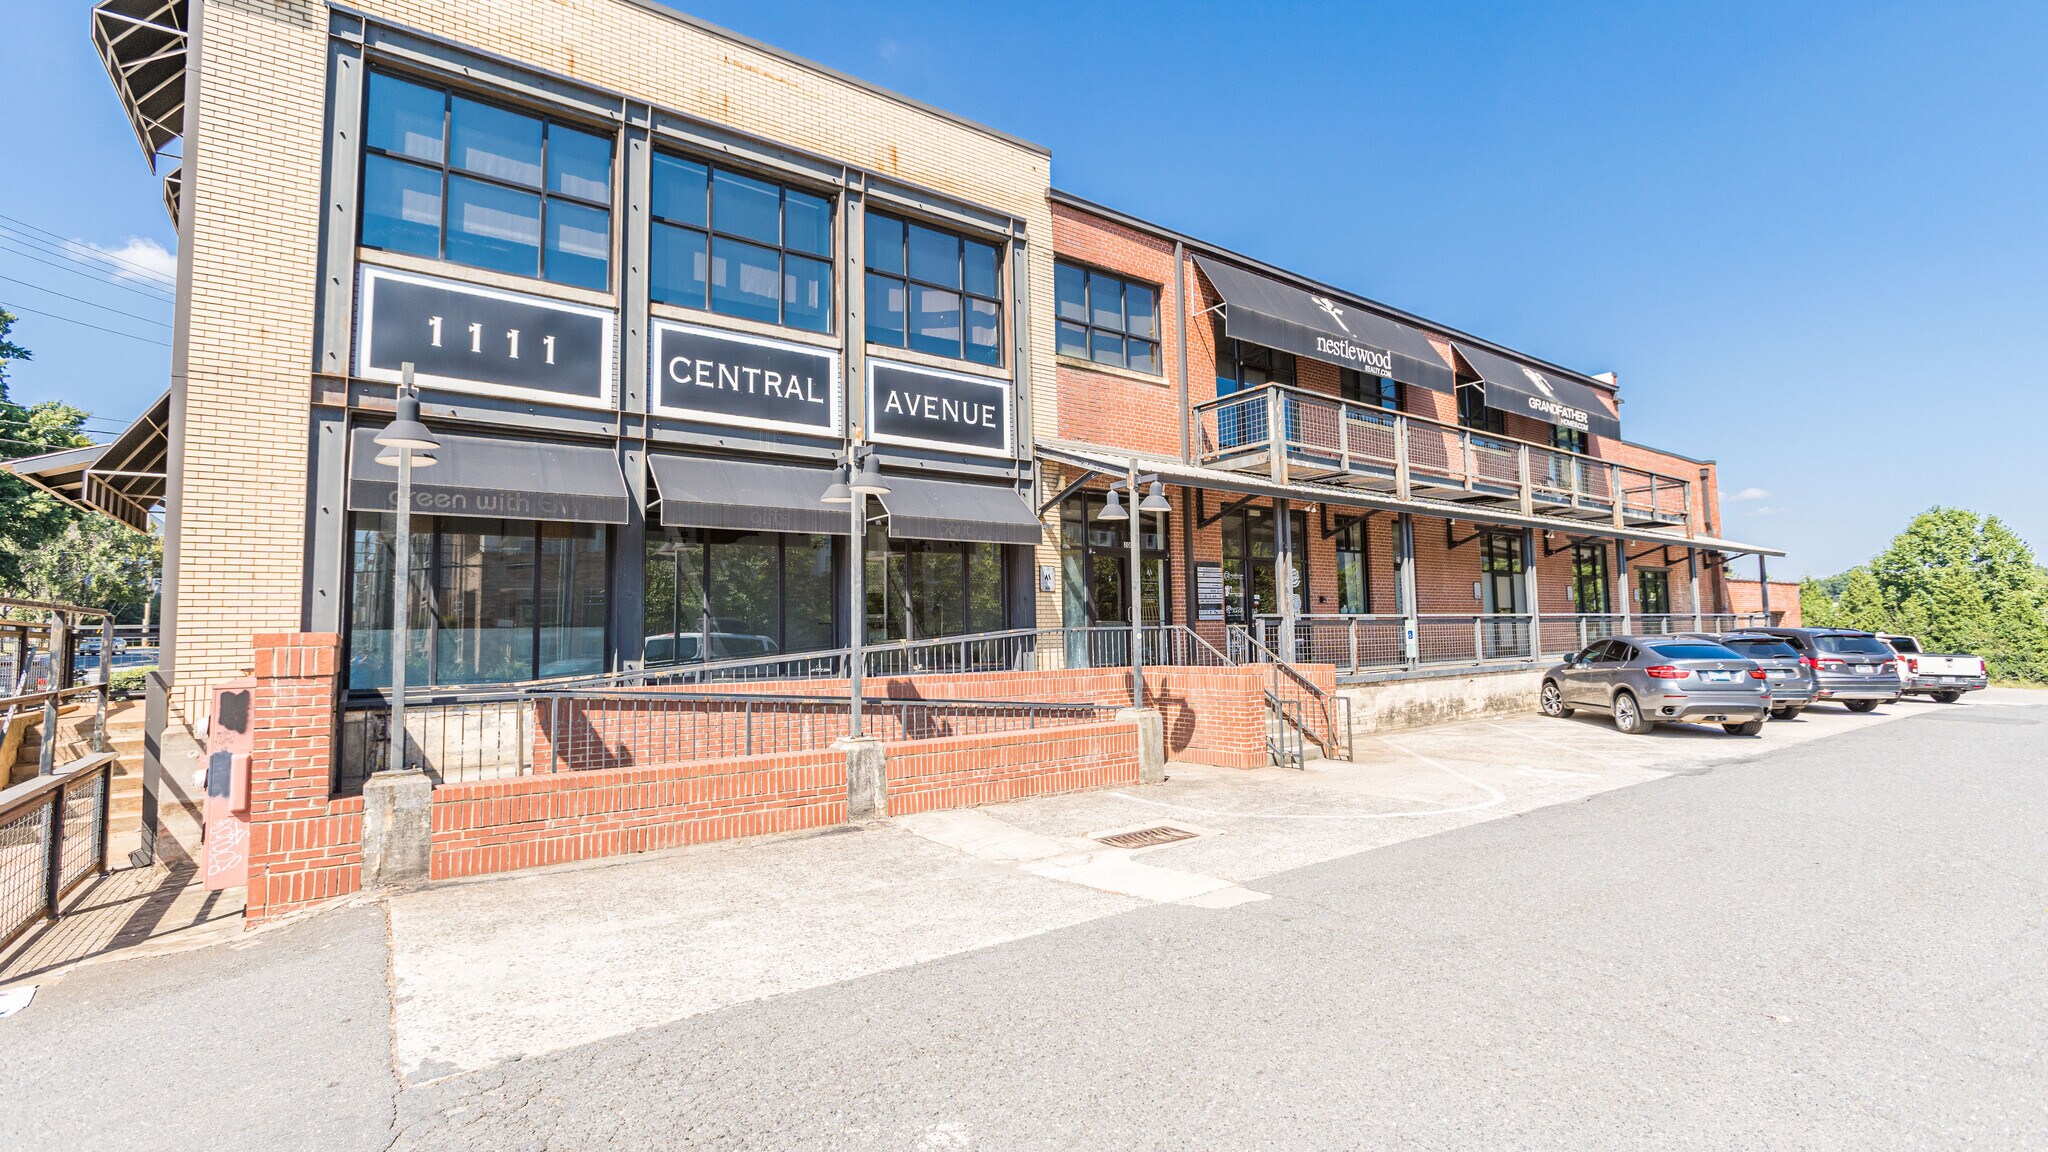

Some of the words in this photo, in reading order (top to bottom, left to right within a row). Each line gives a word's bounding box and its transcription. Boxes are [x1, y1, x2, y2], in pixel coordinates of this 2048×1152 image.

[428, 315, 556, 365] 1111
[1316, 336, 1392, 370] nestlewood
[668, 356, 824, 404] CENTRAL
[1364, 364, 1392, 378] REALTY.COM
[884, 389, 997, 429] AVENUE
[1528, 397, 1588, 424] GRANDFATHER
[476, 492, 530, 512] with
